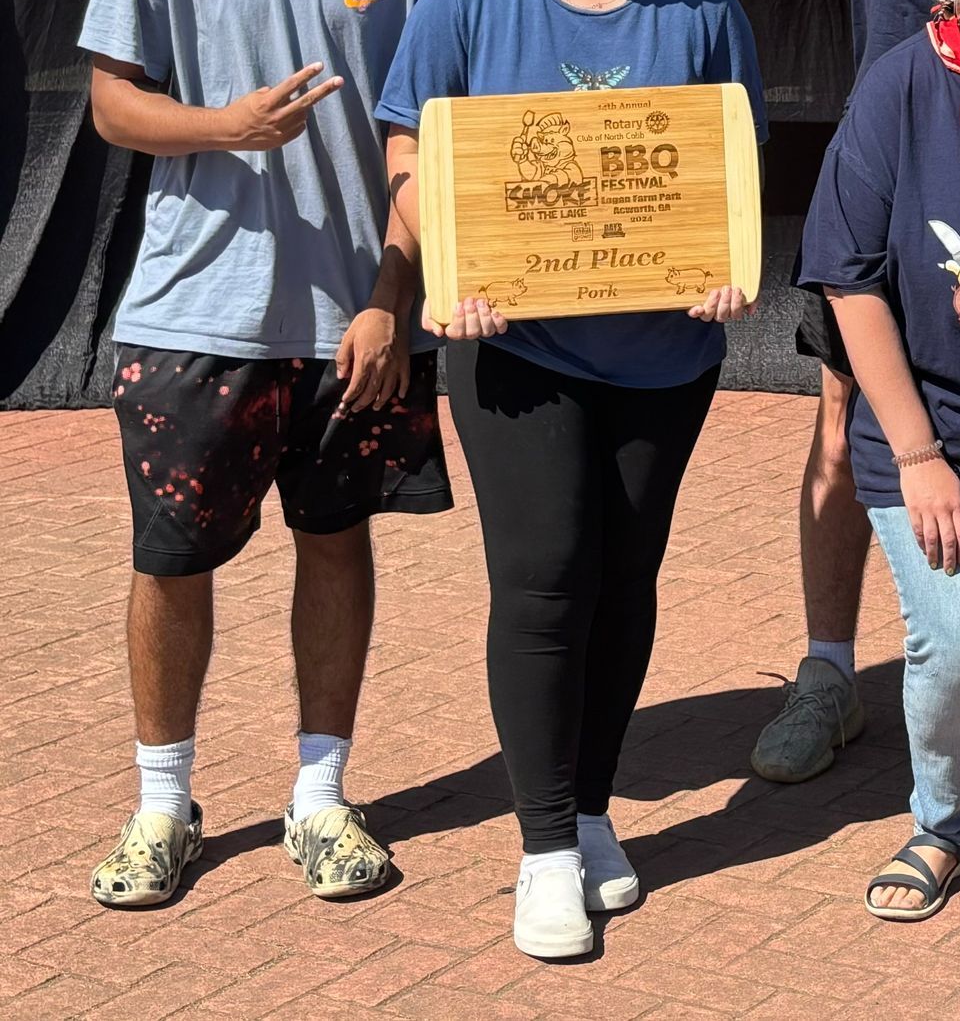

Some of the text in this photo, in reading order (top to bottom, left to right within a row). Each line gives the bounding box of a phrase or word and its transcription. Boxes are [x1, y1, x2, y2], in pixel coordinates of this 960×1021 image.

[619, 100, 651, 110] Annual
[604, 119, 643, 131] Rotary
[576, 134, 593, 143] Club
[595, 133, 602, 141] of
[604, 133, 624, 141] North
[600, 143, 679, 179] BBQ
[601, 176, 667, 192] FESTIVAL
[508, 179, 592, 209] SMOKE
[601, 192, 682, 205] Logan Farm Park
[518, 208, 587, 221] ON THE LAKE
[630, 215, 653, 223] 2024
[525, 247, 667, 274] 2nd Place
[577, 283, 618, 300] Pork
